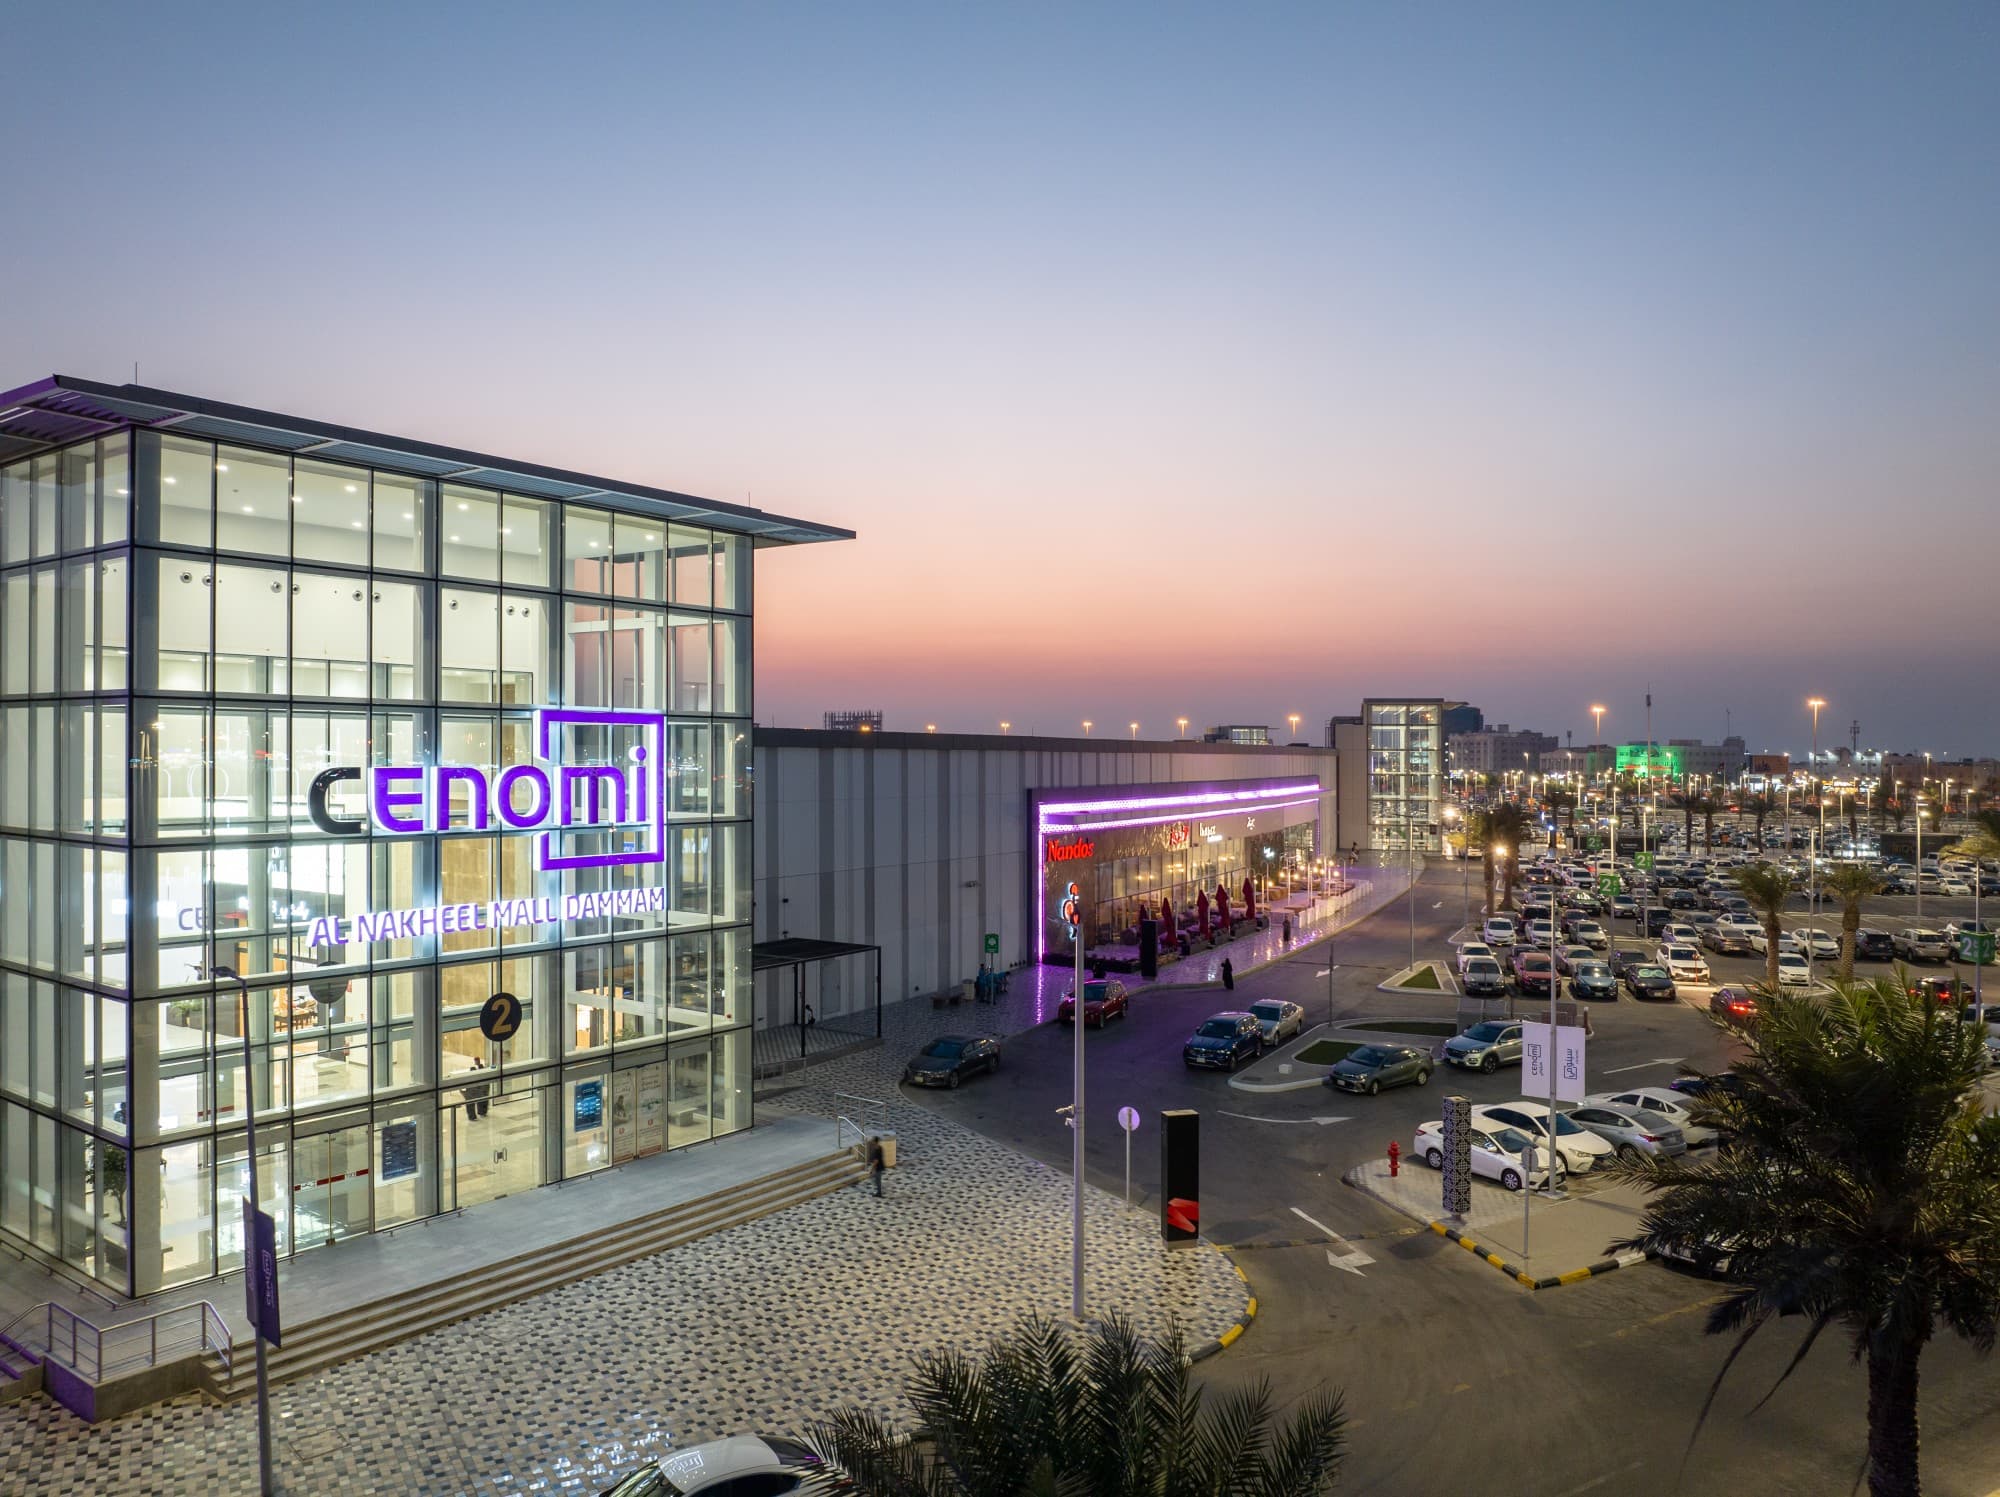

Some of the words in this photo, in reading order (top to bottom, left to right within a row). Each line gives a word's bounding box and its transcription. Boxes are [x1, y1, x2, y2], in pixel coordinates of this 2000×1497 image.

[1637, 855, 1645, 866] 2
[1602, 878, 1611, 891] 2
[307, 915, 349, 947] AL
[356, 903, 487, 943] NAKHEEL
[492, 897, 557, 928] MALL
[561, 887, 665, 921] DAMMAM
[1962, 936, 1972, 956] 2
[491, 998, 513, 1035] 2
